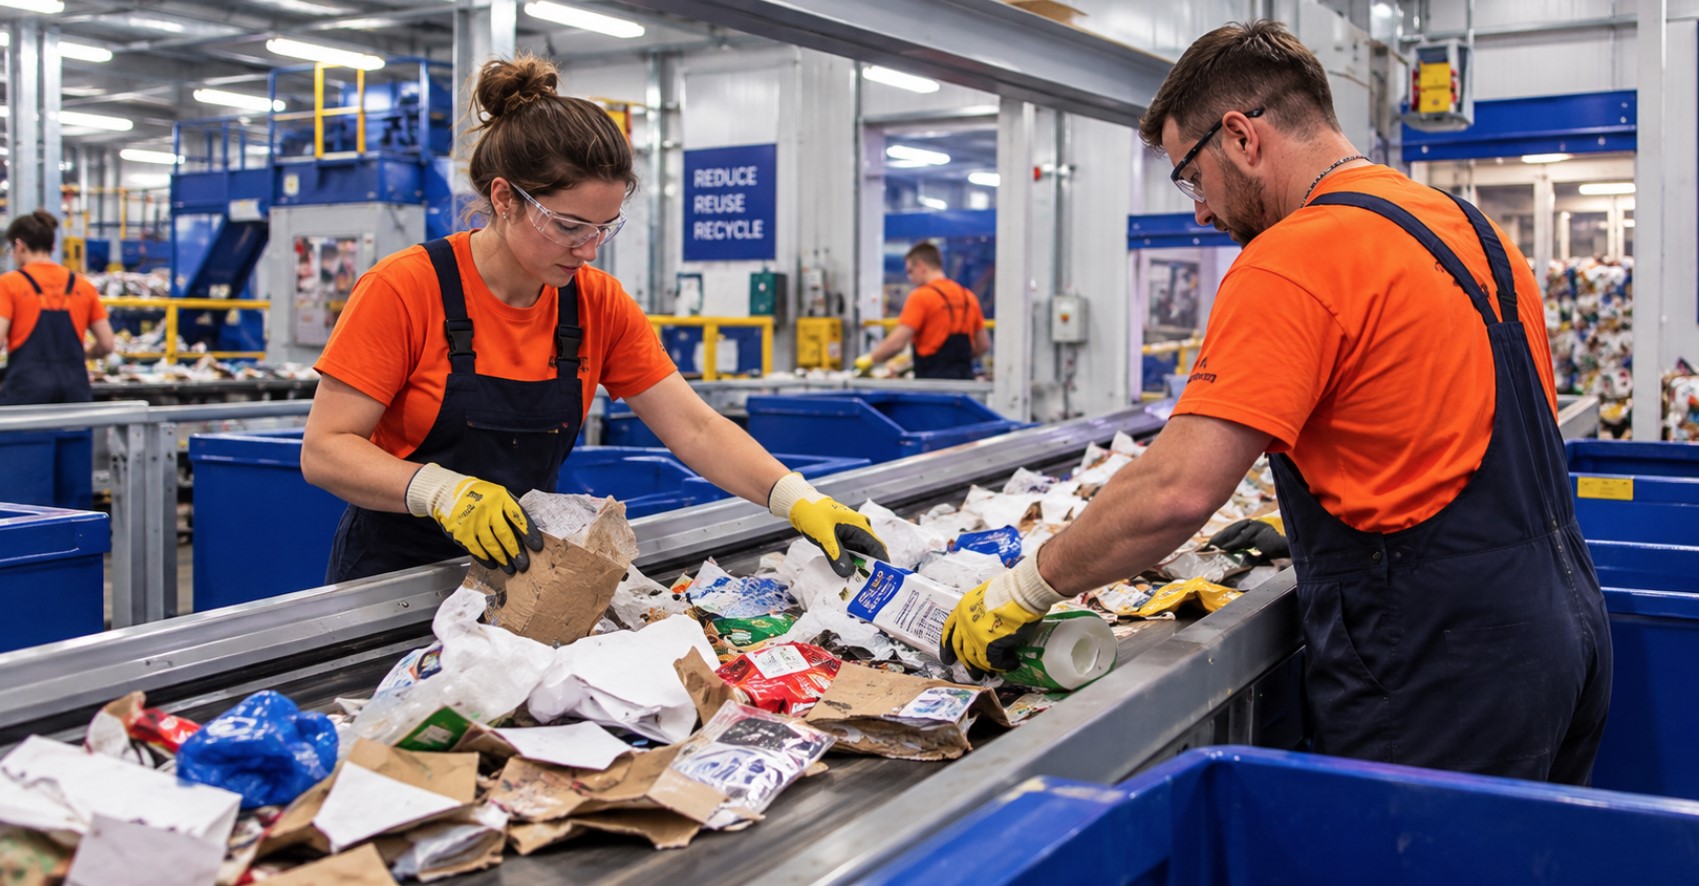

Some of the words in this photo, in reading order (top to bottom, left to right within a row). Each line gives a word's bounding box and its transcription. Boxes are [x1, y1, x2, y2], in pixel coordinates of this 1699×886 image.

[694, 166, 757, 187] REDUCE
[694, 193, 745, 214] REUSE
[694, 219, 764, 240] RECYCLE
